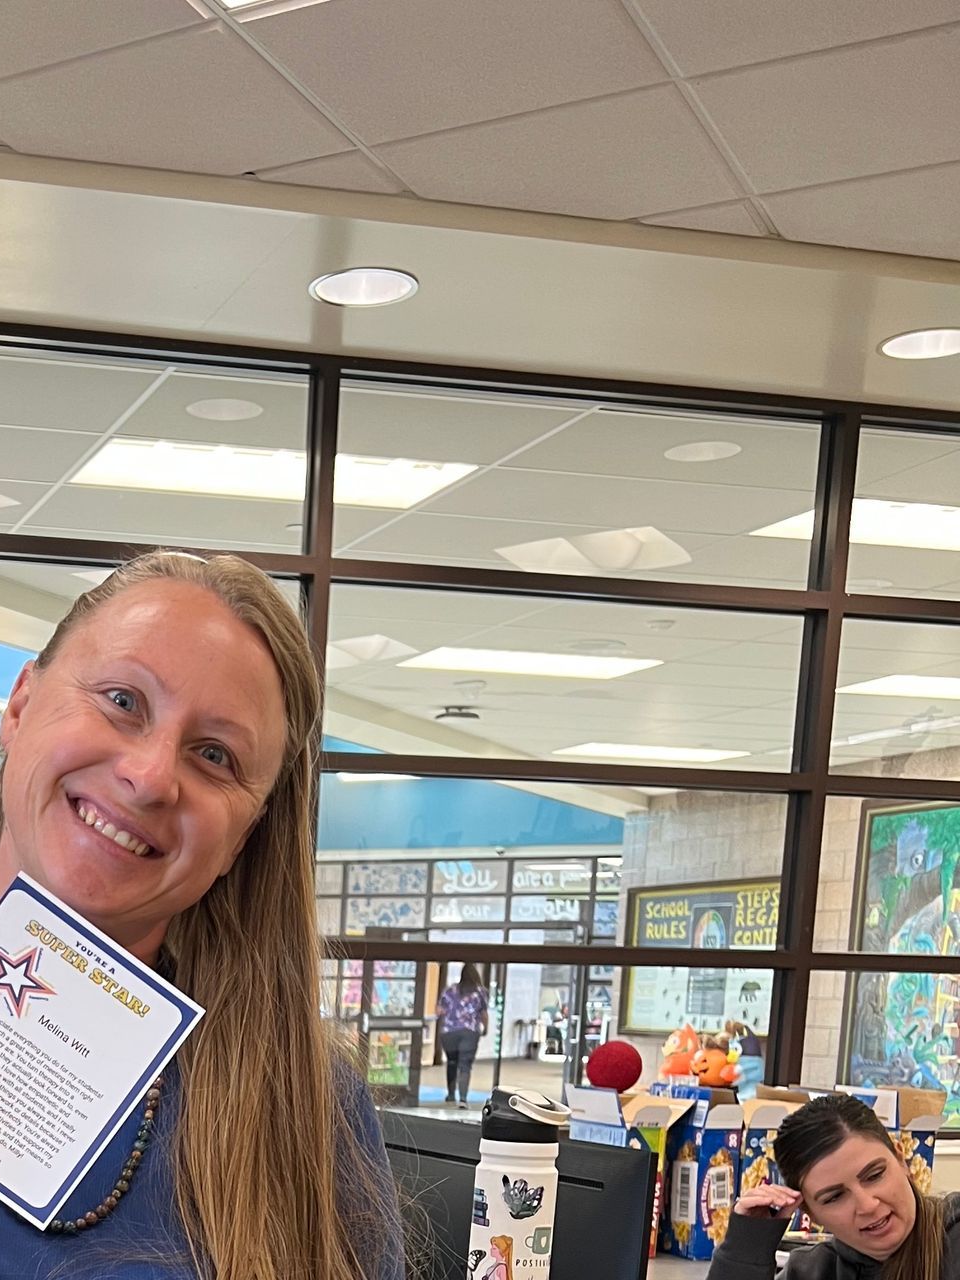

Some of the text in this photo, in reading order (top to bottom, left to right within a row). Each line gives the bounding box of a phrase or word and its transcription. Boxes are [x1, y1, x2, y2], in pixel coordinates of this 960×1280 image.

[438, 862, 498, 894] You
[645, 898, 691, 919] SCHOOL
[736, 889, 780, 908] STEPS
[645, 921, 687, 940] RULES
[24, 919, 150, 1017] SUPER STAR!
[75, 940, 107, 967] YOU'RE
[37, 1014, 89, 1057] Melina Witt
[9, 1039, 25, 1052] great
[24, 1050, 36, 1060] way
[42, 1063, 65, 1082] meeting
[64, 1080, 80, 1093] them
[79, 1091, 93, 1102] right
[12, 1031, 41, 1053] everything
[40, 1051, 52, 1061] you
[51, 1059, 60, 1067] do
[59, 1064, 68, 1073] for
[67, 1071, 77, 1080] my
[16, 1053, 27, 1064] You
[26, 1062, 38, 1073] turn
[38, 1070, 59, 1088] therapy
[58, 1086, 70, 1096] into
[0, 1052, 12, 1063] they
[11, 1062, 33, 1079] actually
[32, 1077, 45, 1089] look
[45, 1086, 67, 1104] forward
[74, 1109, 87, 1120] even
[2, 1076, 14, 1087] with
[13, 1085, 23, 1093] all
[46, 1109, 58, 1119] and
[59, 1119, 75, 1132] really
[3, 1066, 16, 1078] love
[15, 1075, 28, 1086] how
[27, 1085, 59, 1109] empathetic
[58, 1107, 70, 1118] and
[15, 1097, 27, 1107] you
[26, 1106, 46, 1121] always
[59, 1130, 75, 1142] never
[20, 1111, 39, 1127] details
[38, 1125, 62, 1144] because
[2, 1130, 14, 1141] and
[13, 1138, 25, 1149] that
[24, 1147, 44, 1163] means
[22, 1135, 44, 1152] support
[43, 1150, 53, 1159] my
[40, 1137, 59, 1153] always
